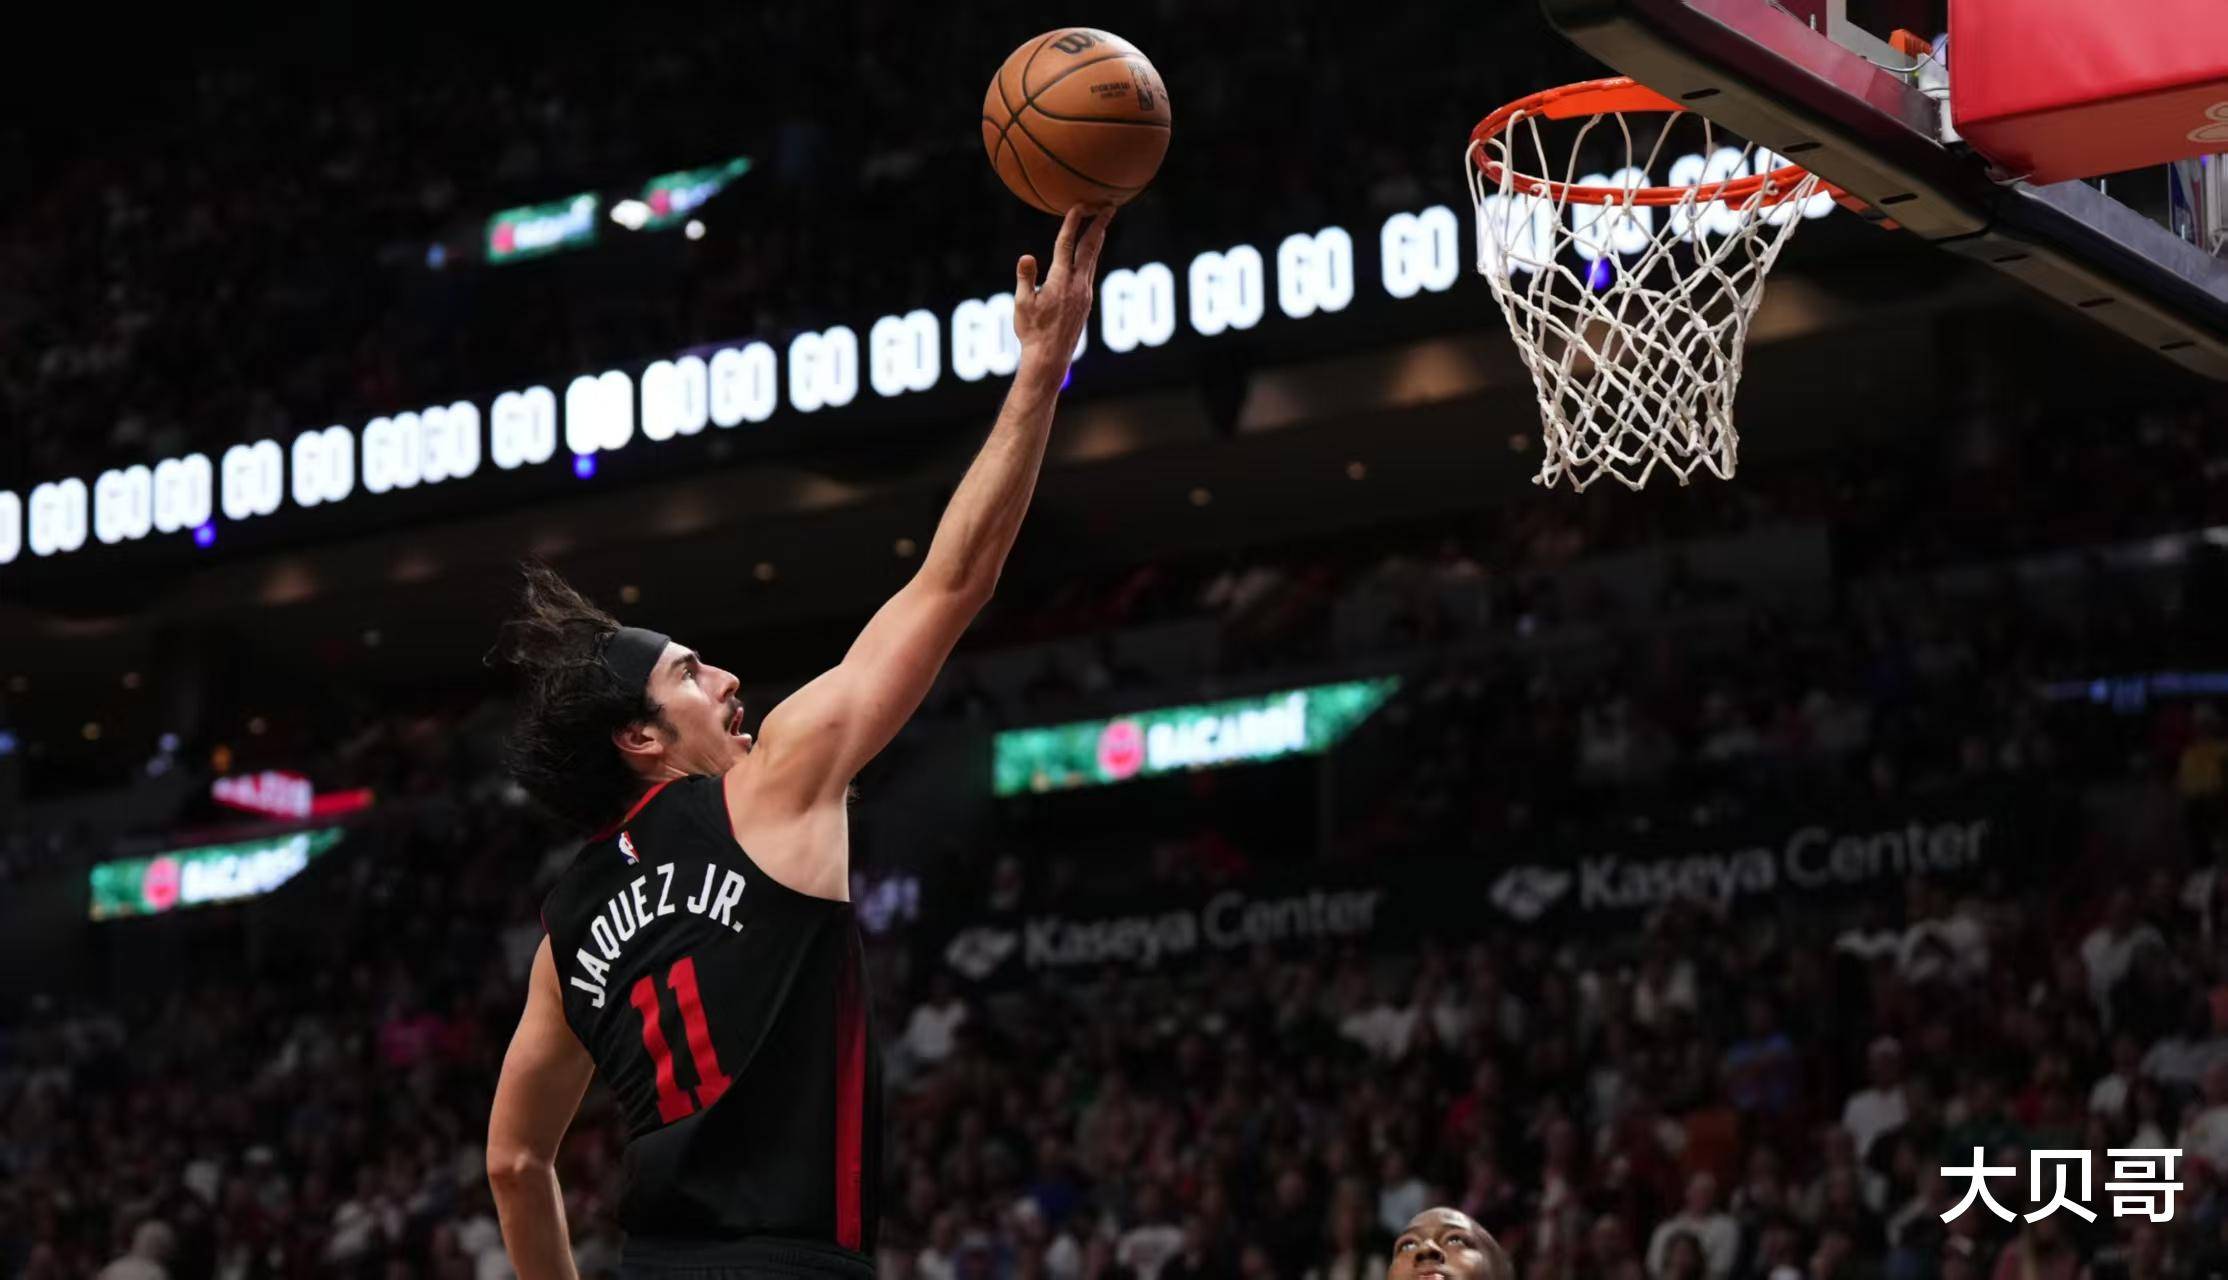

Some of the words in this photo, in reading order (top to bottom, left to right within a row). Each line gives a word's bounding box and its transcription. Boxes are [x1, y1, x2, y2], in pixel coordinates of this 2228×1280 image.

[1580, 848, 1775, 909] Kaseya
[1786, 819, 1989, 887] Center
[570, 862, 676, 1008] JAQUEZ
[687, 863, 746, 933] JR.
[1025, 910, 1196, 969] Kaseya
[1202, 889, 1379, 948] Center
[629, 956, 732, 1124] 11
